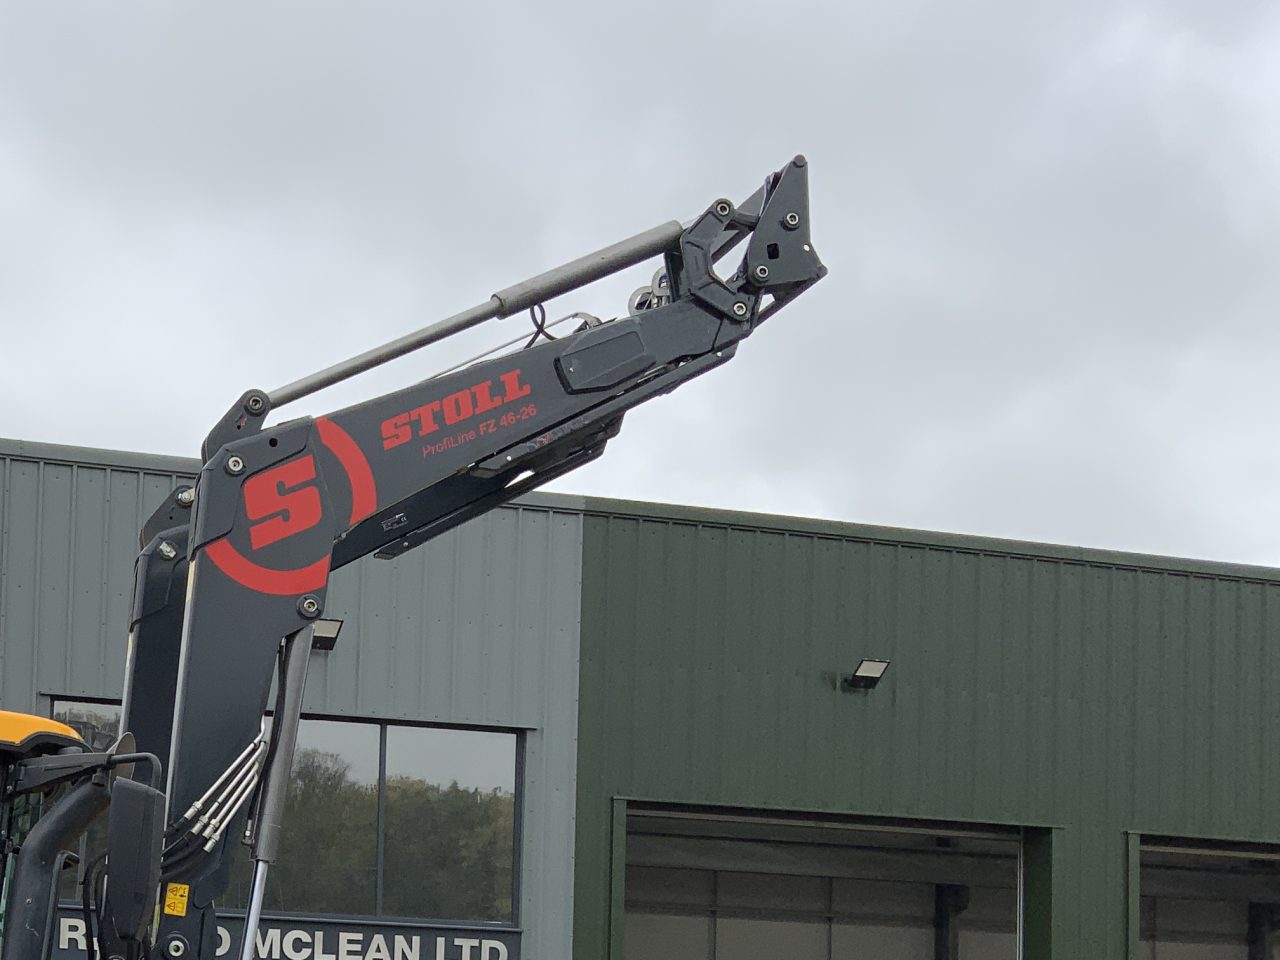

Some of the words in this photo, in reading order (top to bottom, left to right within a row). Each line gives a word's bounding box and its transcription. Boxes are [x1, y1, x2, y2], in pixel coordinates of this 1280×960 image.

[380, 368, 532, 451] STOLL
[422, 430, 477, 459] ProfiLine
[479, 419, 497, 436] FZ
[500, 403, 537, 427] 46-26
[243, 454, 322, 550] S
